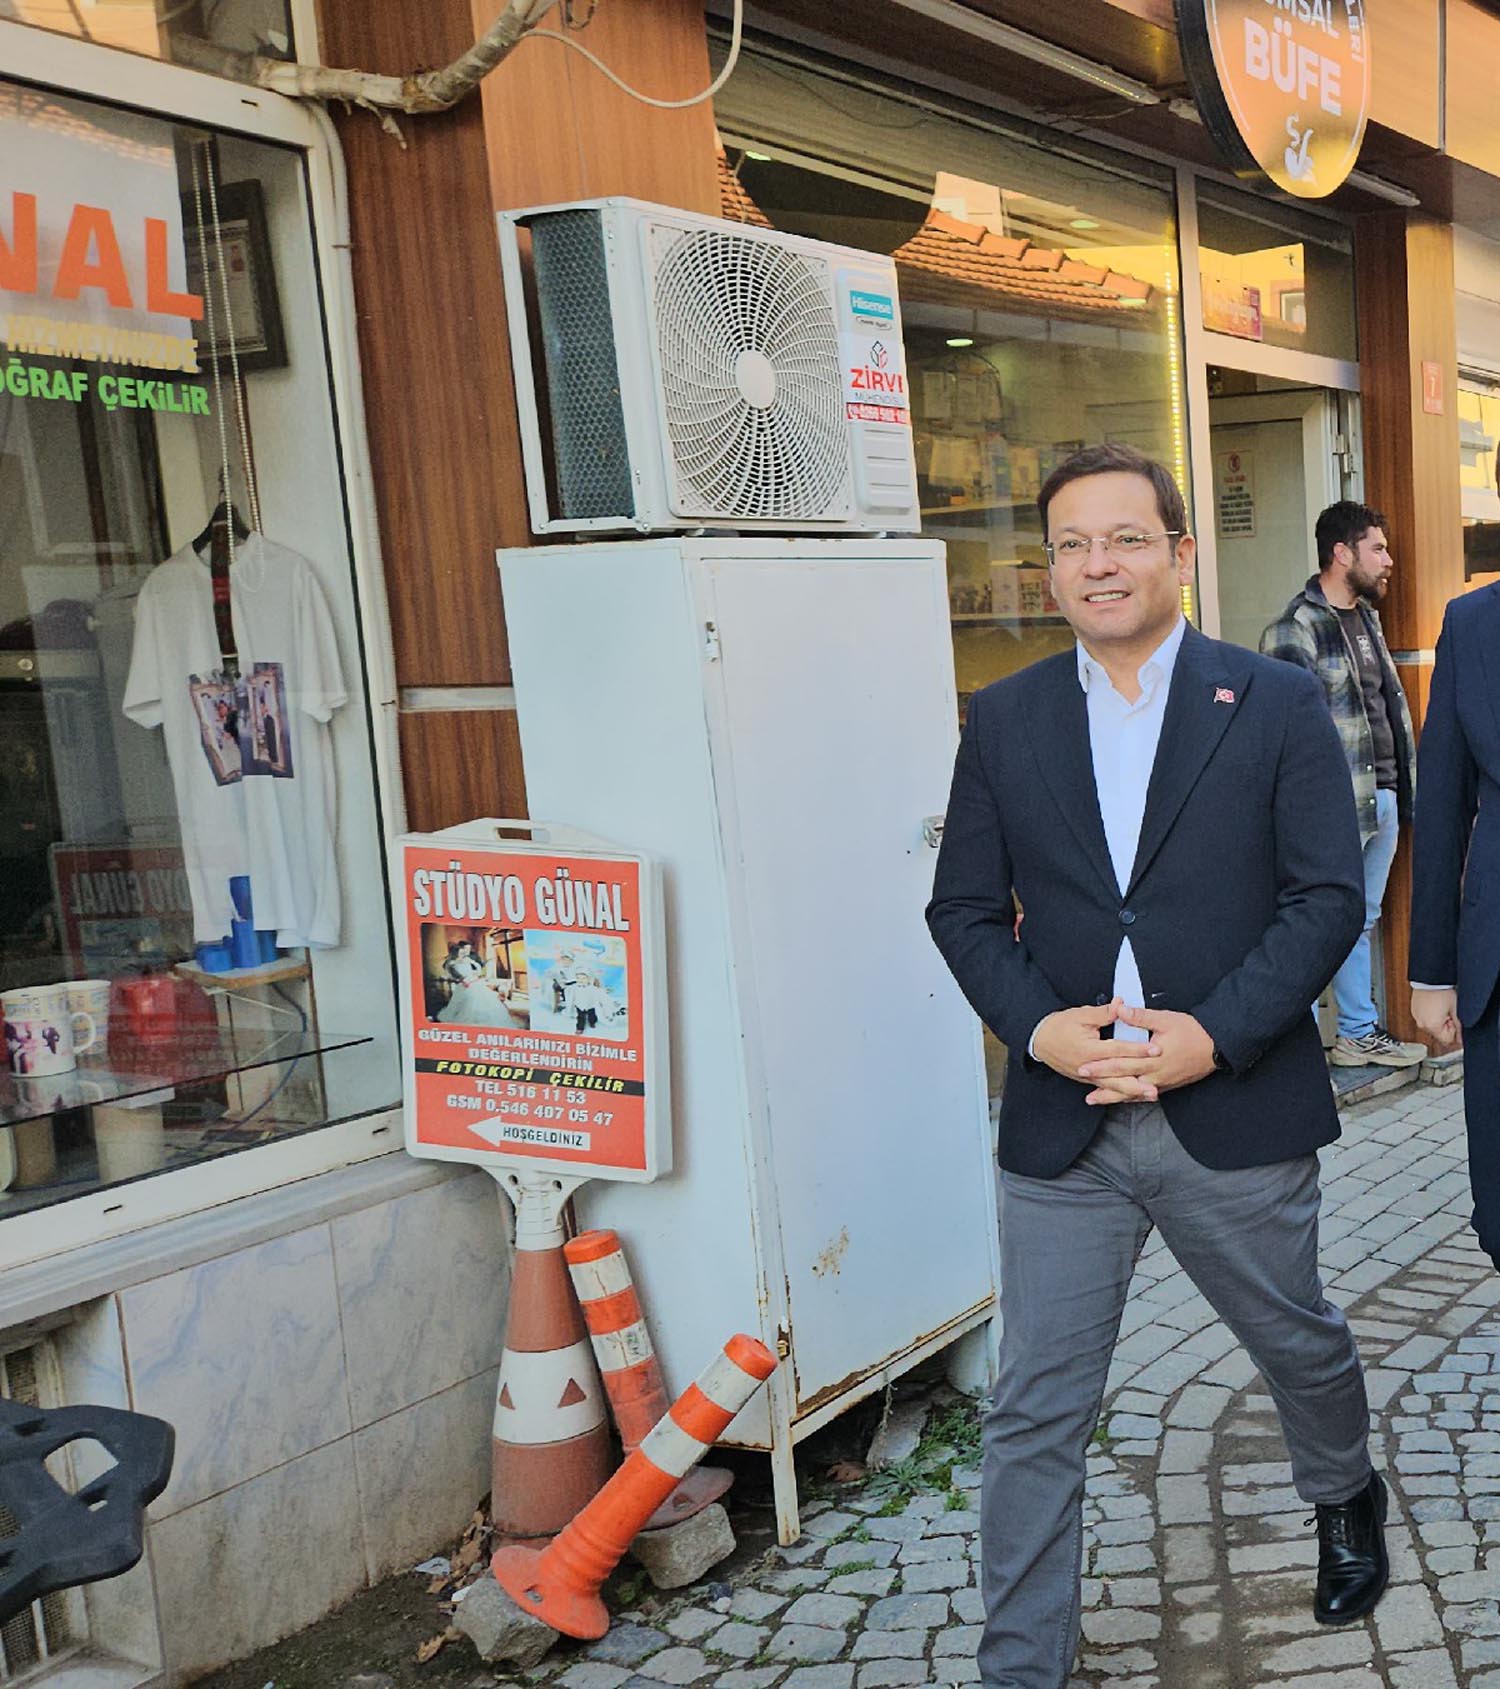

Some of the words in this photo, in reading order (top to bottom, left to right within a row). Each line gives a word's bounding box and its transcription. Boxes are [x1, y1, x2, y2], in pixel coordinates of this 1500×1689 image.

[1244, 16, 1342, 117] BÜFE
[413, 859, 526, 925] STÜDYO
[534, 867, 631, 932] GÜNAL
[418, 1028, 472, 1044] GÜZEL
[576, 1042, 637, 1062] BİZİMLE
[468, 1046, 593, 1071] DEĞERLENDİRİN
[436, 1061, 533, 1081] FOTOKOPİ
[549, 1072, 625, 1093] ÇEKİLİR
[475, 1079, 503, 1095] TEL
[542, 1087, 560, 1102] 11
[566, 1090, 586, 1105] 53
[447, 1094, 482, 1111] GSM
[486, 1098, 529, 1116] 0.546
[568, 1108, 589, 1123] 05
[593, 1111, 614, 1127] 47
